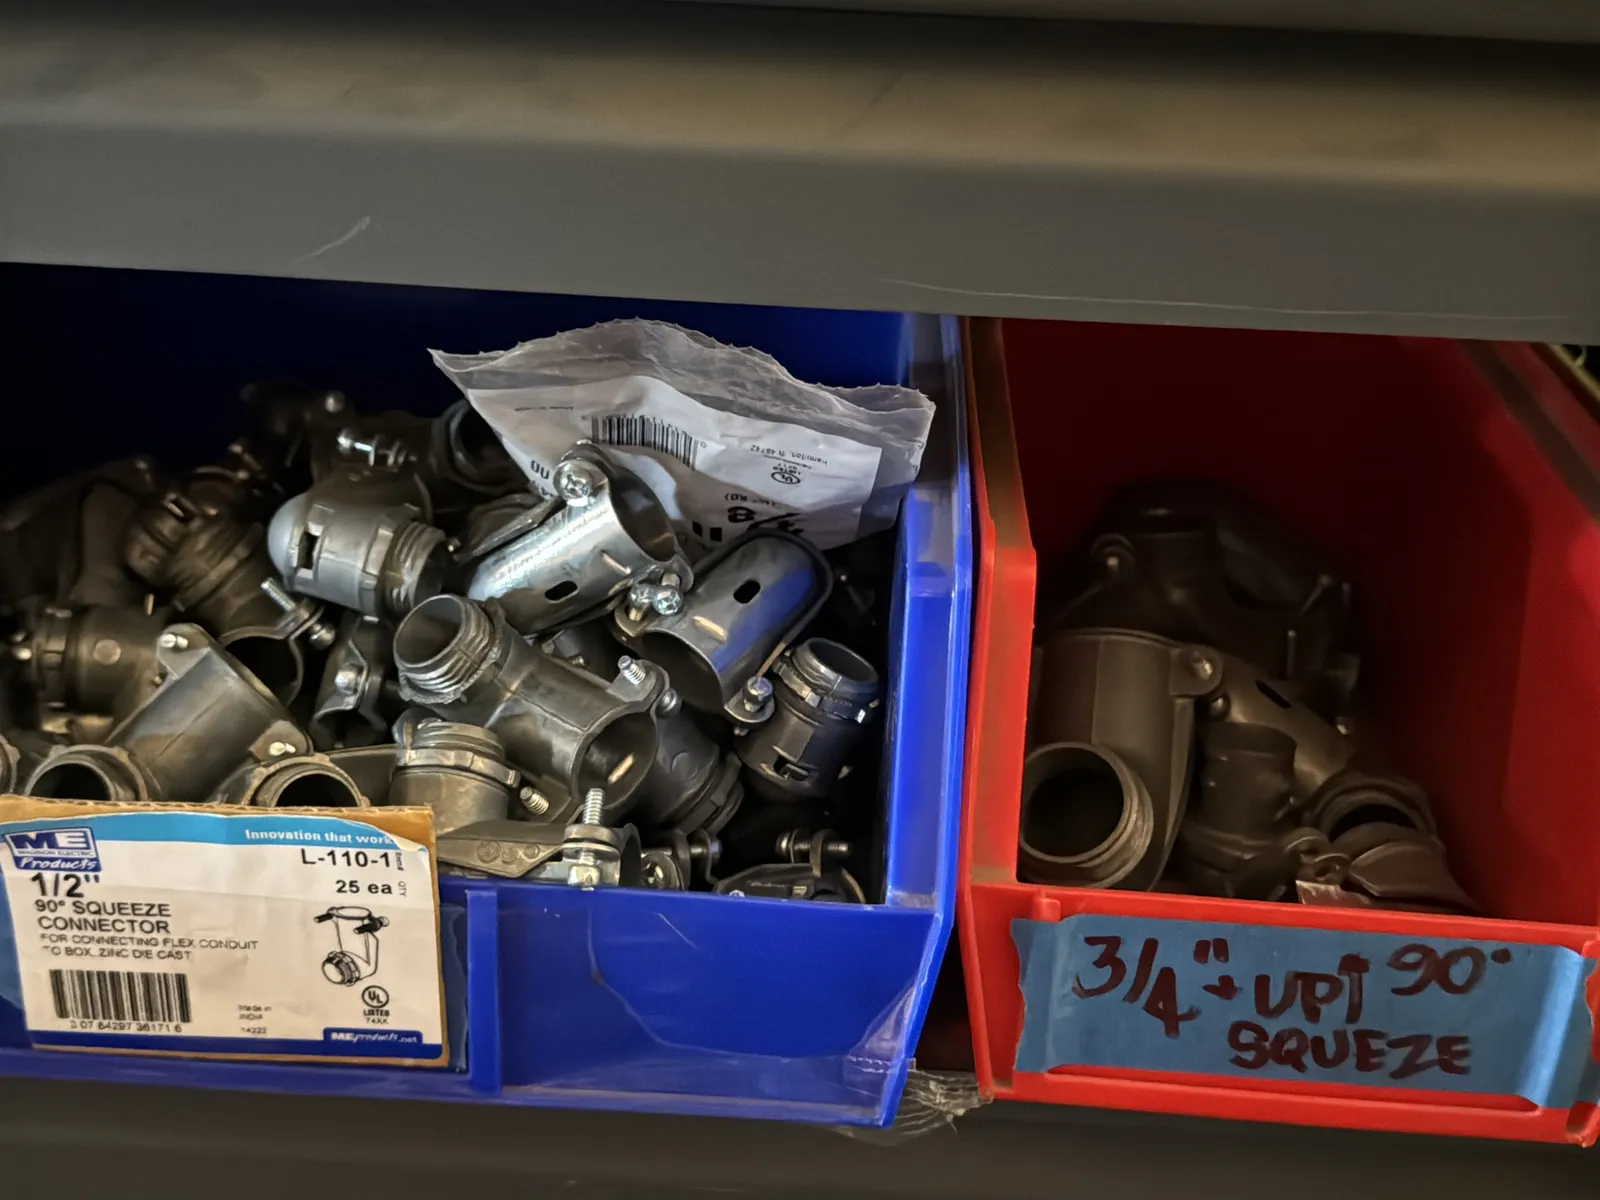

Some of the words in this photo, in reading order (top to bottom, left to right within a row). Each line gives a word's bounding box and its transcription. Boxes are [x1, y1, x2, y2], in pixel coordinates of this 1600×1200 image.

[10, 830, 91, 850] ME
[245, 829, 321, 841] Innovation
[324, 832, 352, 843] that
[57, 849, 95, 857] ELECTRIC
[300, 848, 390, 868] L-110-1
[20, 856, 98, 871] Products
[31, 871, 100, 898] 1/2"
[335, 879, 360, 894] 25
[367, 882, 393, 895] ea
[398, 880, 407, 898] QTY
[35, 899, 65, 913] 90°
[72, 900, 172, 917] SQUEEZE
[38, 915, 171, 934] CONNECTOR
[40, 933, 68, 943] FOR
[71, 935, 159, 948] CONNECTING
[162, 938, 195, 948] FLEX
[199, 939, 259, 950] CONDUIT
[100, 948, 129, 958] ZINC
[132, 949, 153, 959] DIE
[157, 949, 192, 961] CAST
[362, 1008, 390, 1018] LISTED
[1228, 1020, 1471, 1080] SQUEZE
